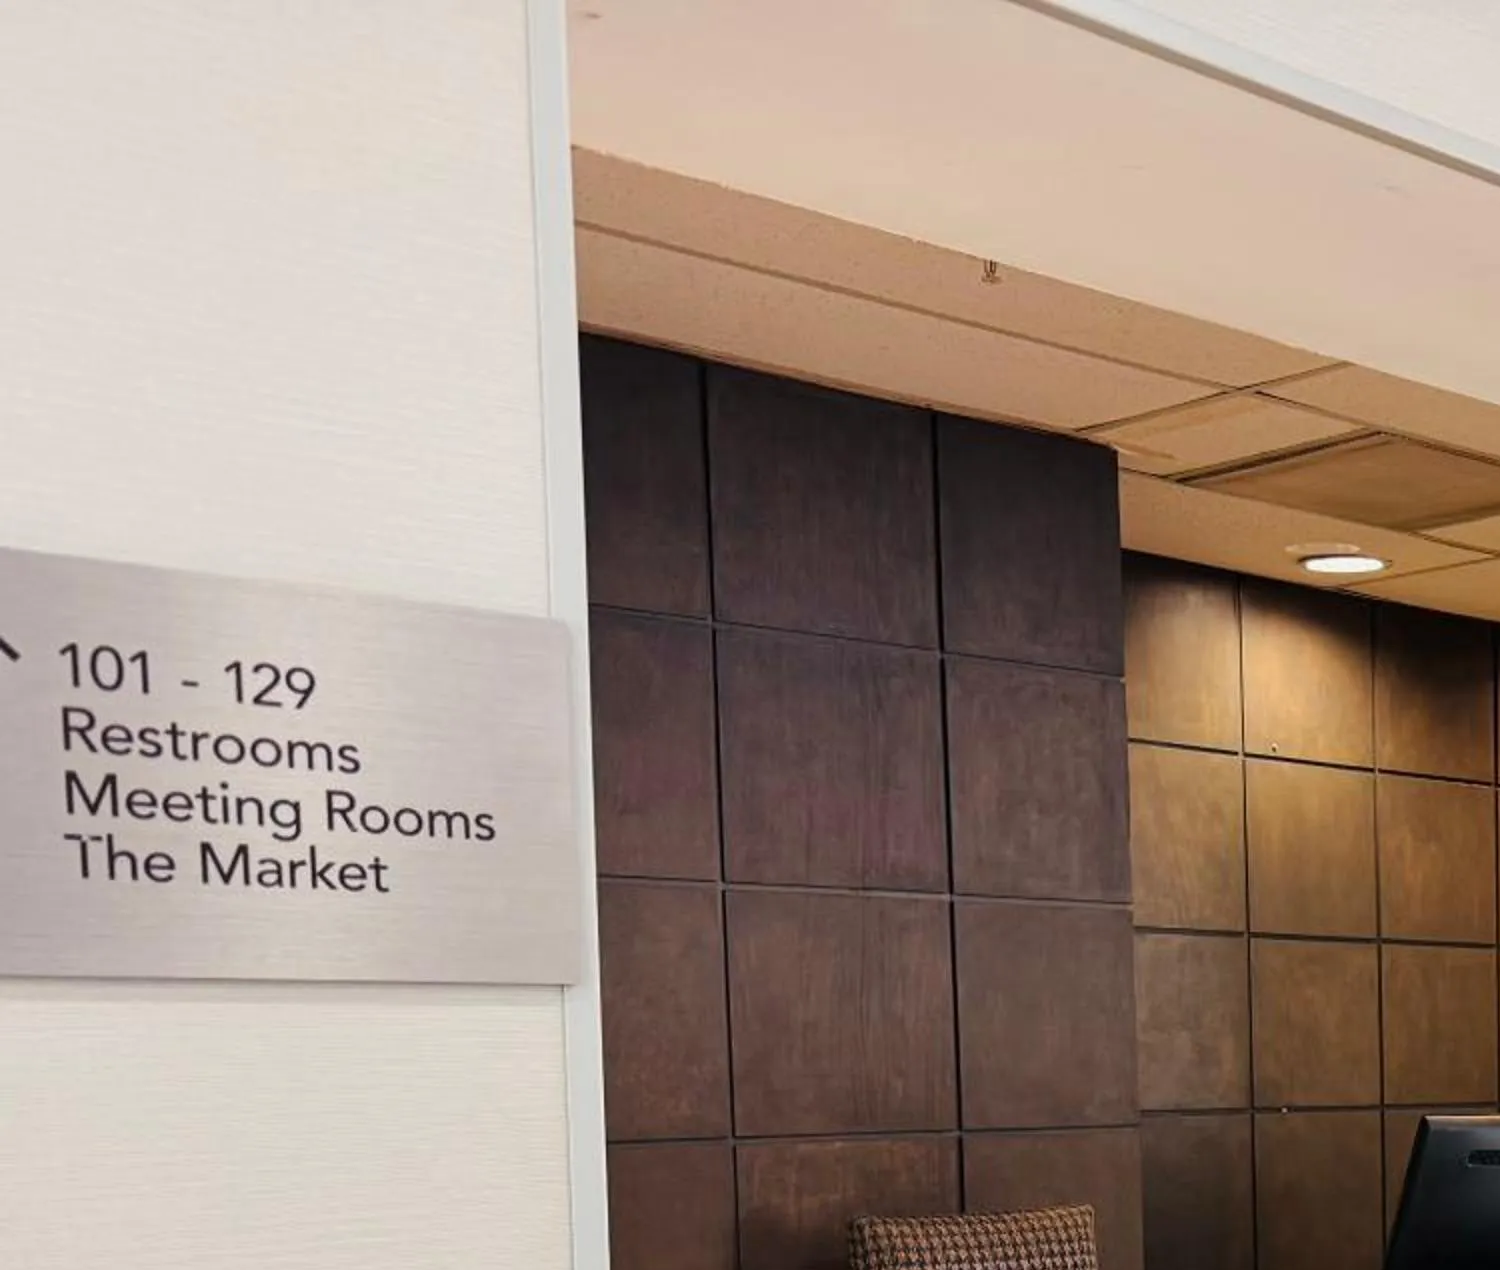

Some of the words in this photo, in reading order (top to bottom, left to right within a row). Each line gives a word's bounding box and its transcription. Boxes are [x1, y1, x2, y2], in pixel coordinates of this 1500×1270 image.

[58, 641, 151, 696] 101
[223, 660, 317, 710] 129
[60, 705, 362, 775] Restrooms
[63, 769, 303, 842] Meeting
[325, 788, 497, 842] Rooms
[62, 832, 177, 884] The
[199, 840, 391, 894] Market
